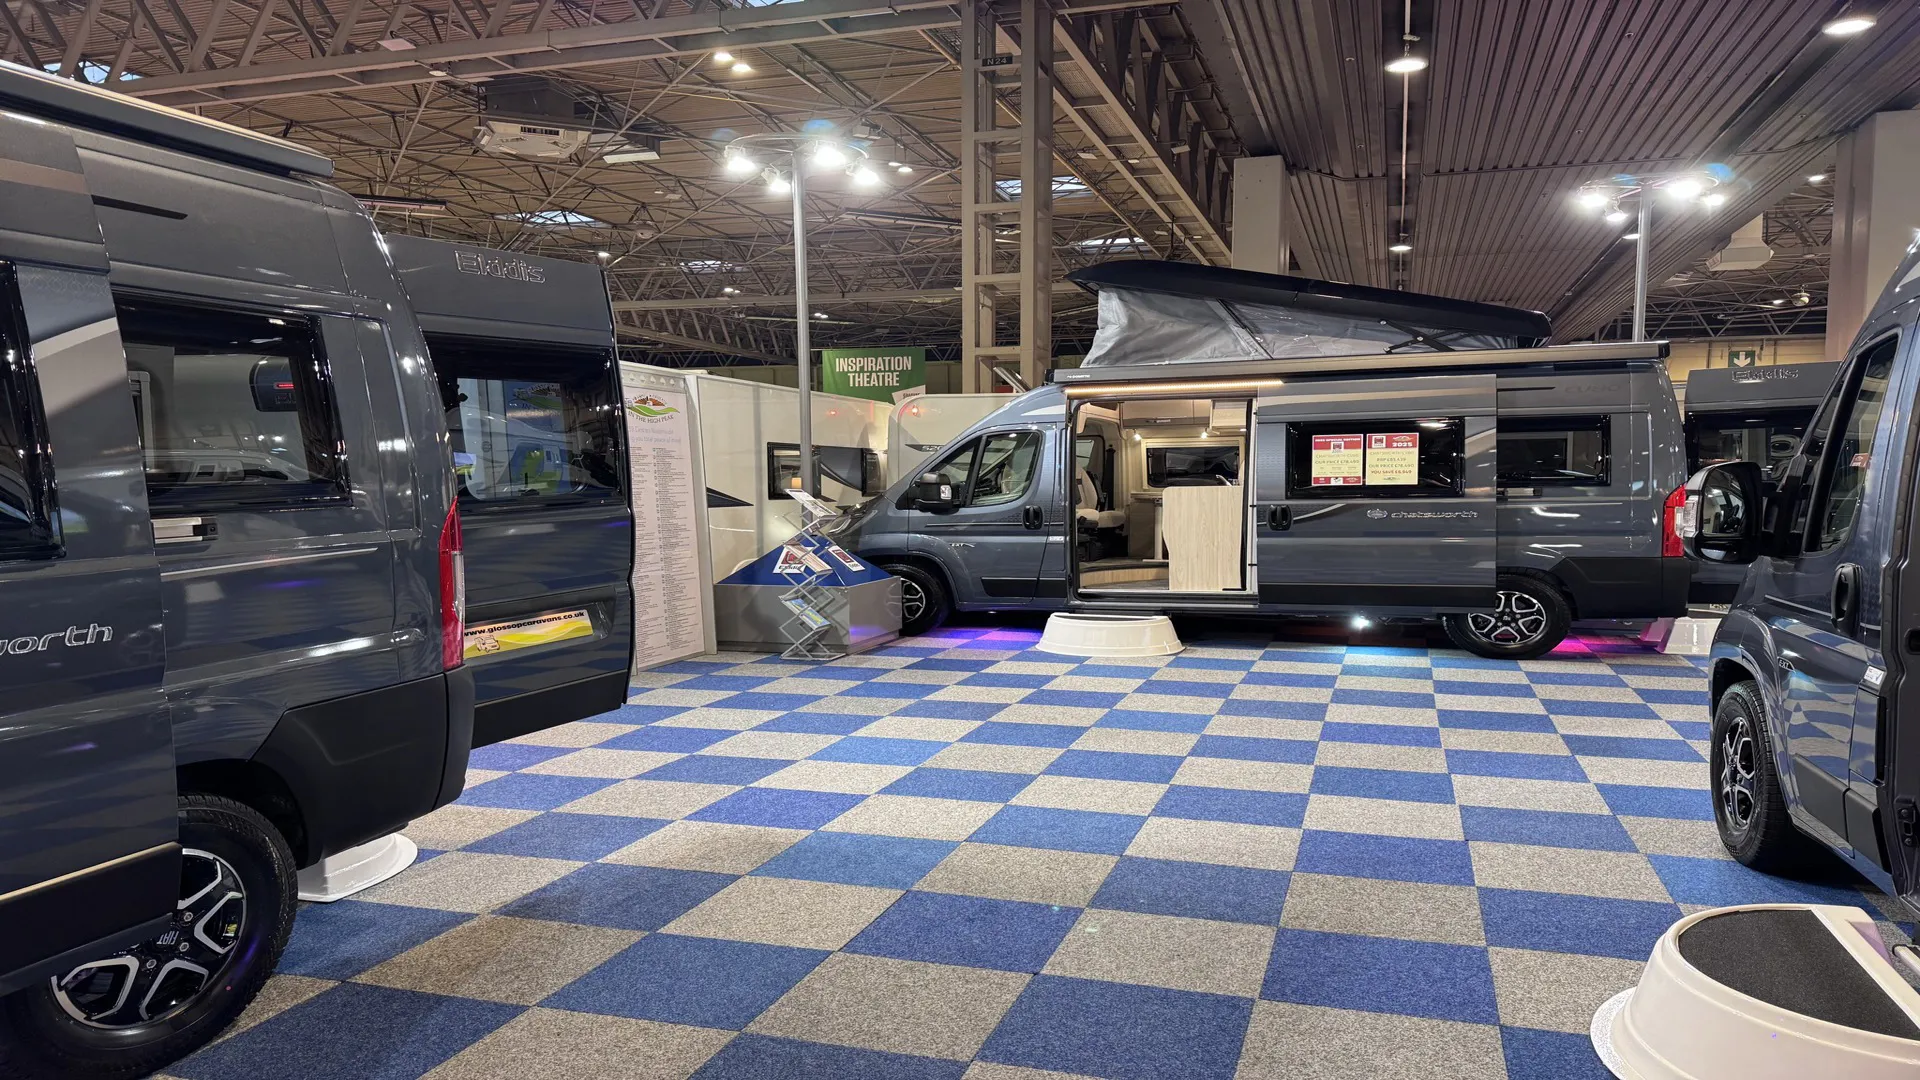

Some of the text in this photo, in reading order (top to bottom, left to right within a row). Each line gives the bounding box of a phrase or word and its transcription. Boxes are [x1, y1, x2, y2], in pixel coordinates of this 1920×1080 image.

[454, 250, 546, 284] Elddis
[835, 356, 912, 372] INSPIRATION
[847, 371, 900, 387] THEATRE
[661, 414, 674, 422] PEAK
[0, 623, 113, 656] orth
[156, 931, 180, 945] FIAT
